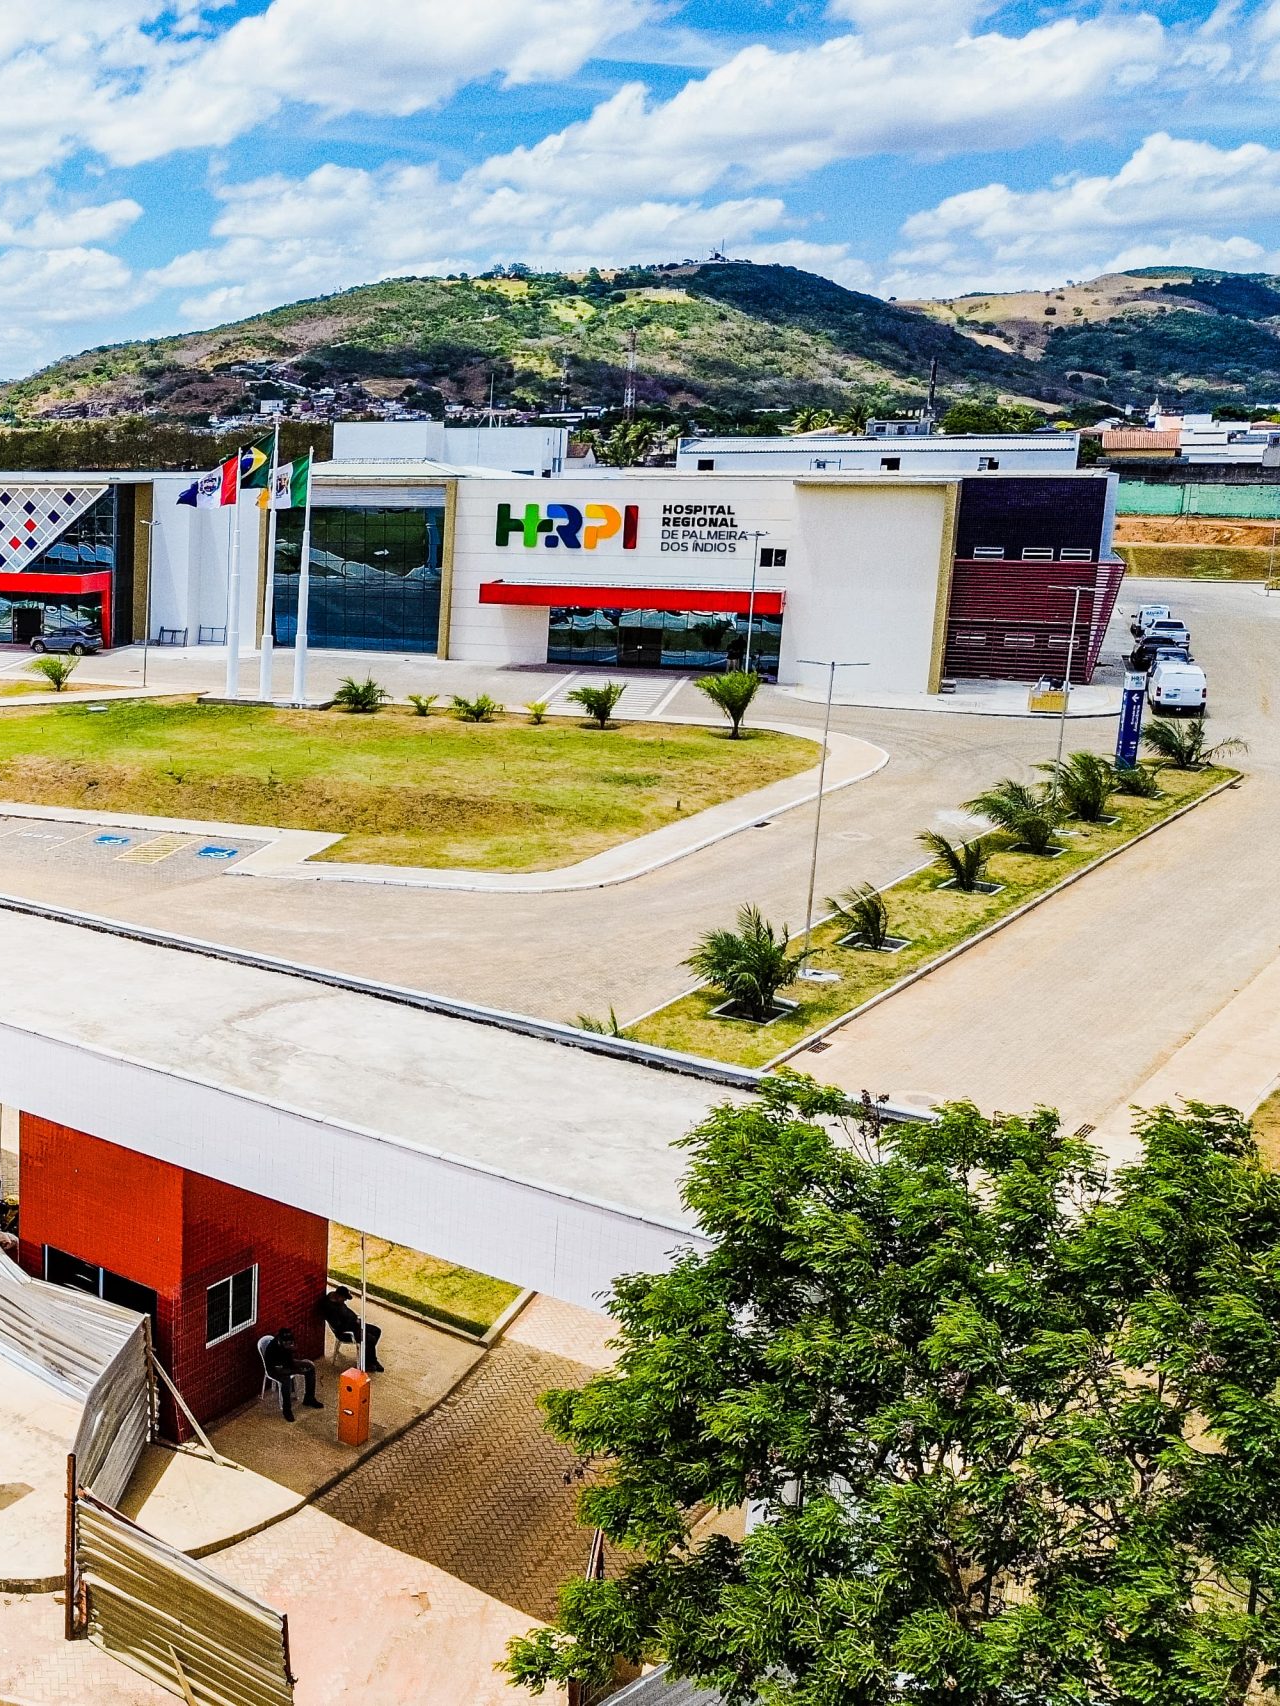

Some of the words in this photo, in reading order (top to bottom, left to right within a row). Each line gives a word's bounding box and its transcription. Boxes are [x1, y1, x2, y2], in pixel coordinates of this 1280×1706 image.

[661, 504, 735, 515] HOSPITAL
[495, 503, 639, 549] HRPI
[661, 516, 738, 528] REGIONAL
[661, 529, 680, 540] DE
[681, 530, 748, 541] PALMEIRA
[660, 541, 689, 552] DOS
[692, 539, 737, 553] ÍNDIOS
